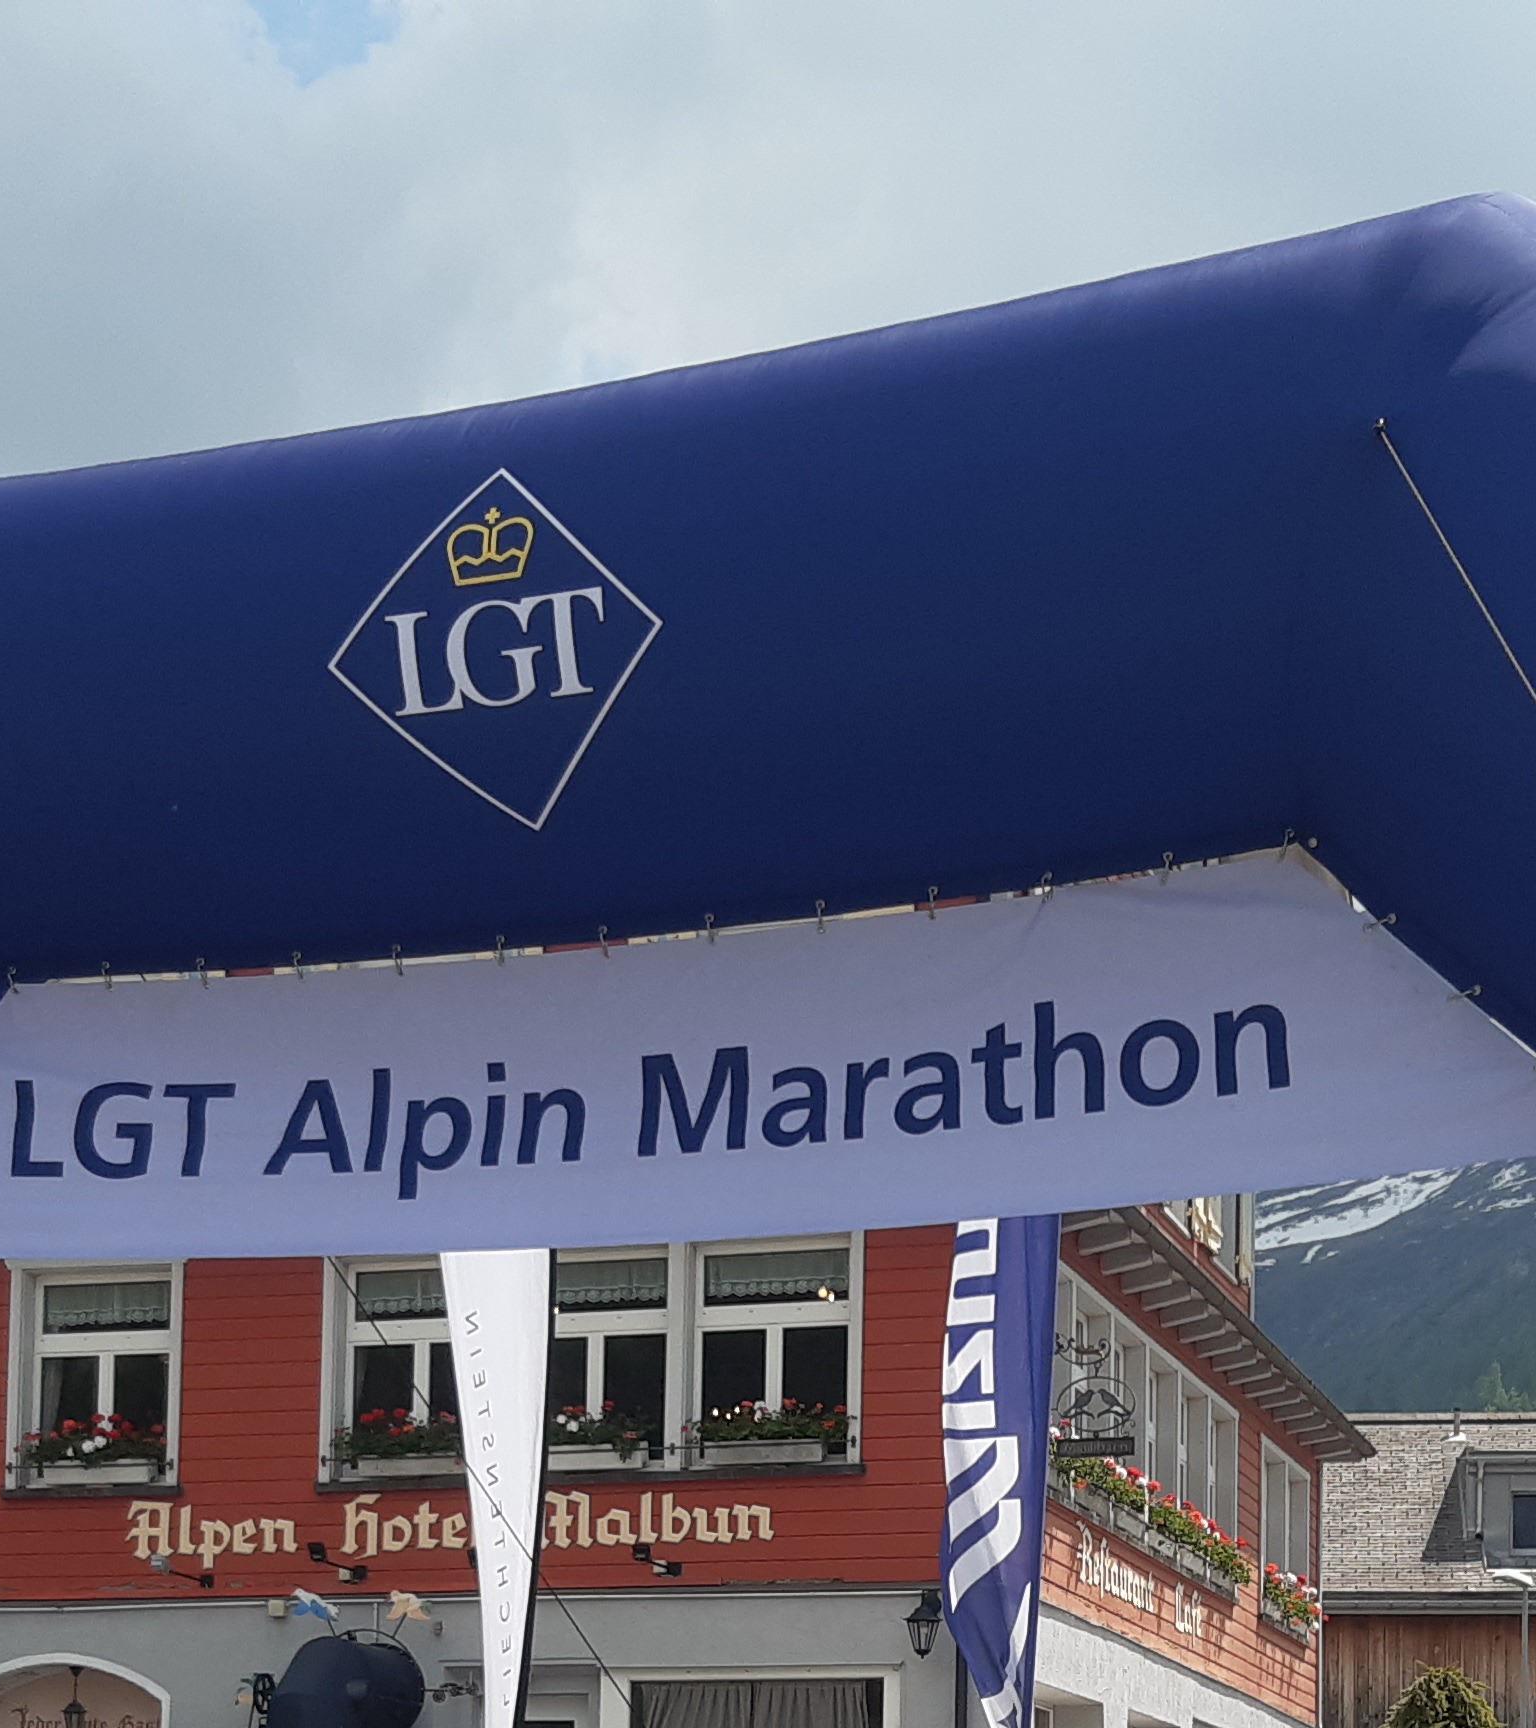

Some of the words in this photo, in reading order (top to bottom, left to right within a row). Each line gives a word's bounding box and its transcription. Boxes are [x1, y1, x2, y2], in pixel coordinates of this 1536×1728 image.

[384, 586, 604, 717] LGT
[10, 1080, 234, 1178] LGT
[265, 1062, 586, 1200] Alpin
[637, 1001, 1292, 1158] Marathon
[124, 1500, 299, 1570] Alpen
[340, 1494, 470, 1560] Hote
